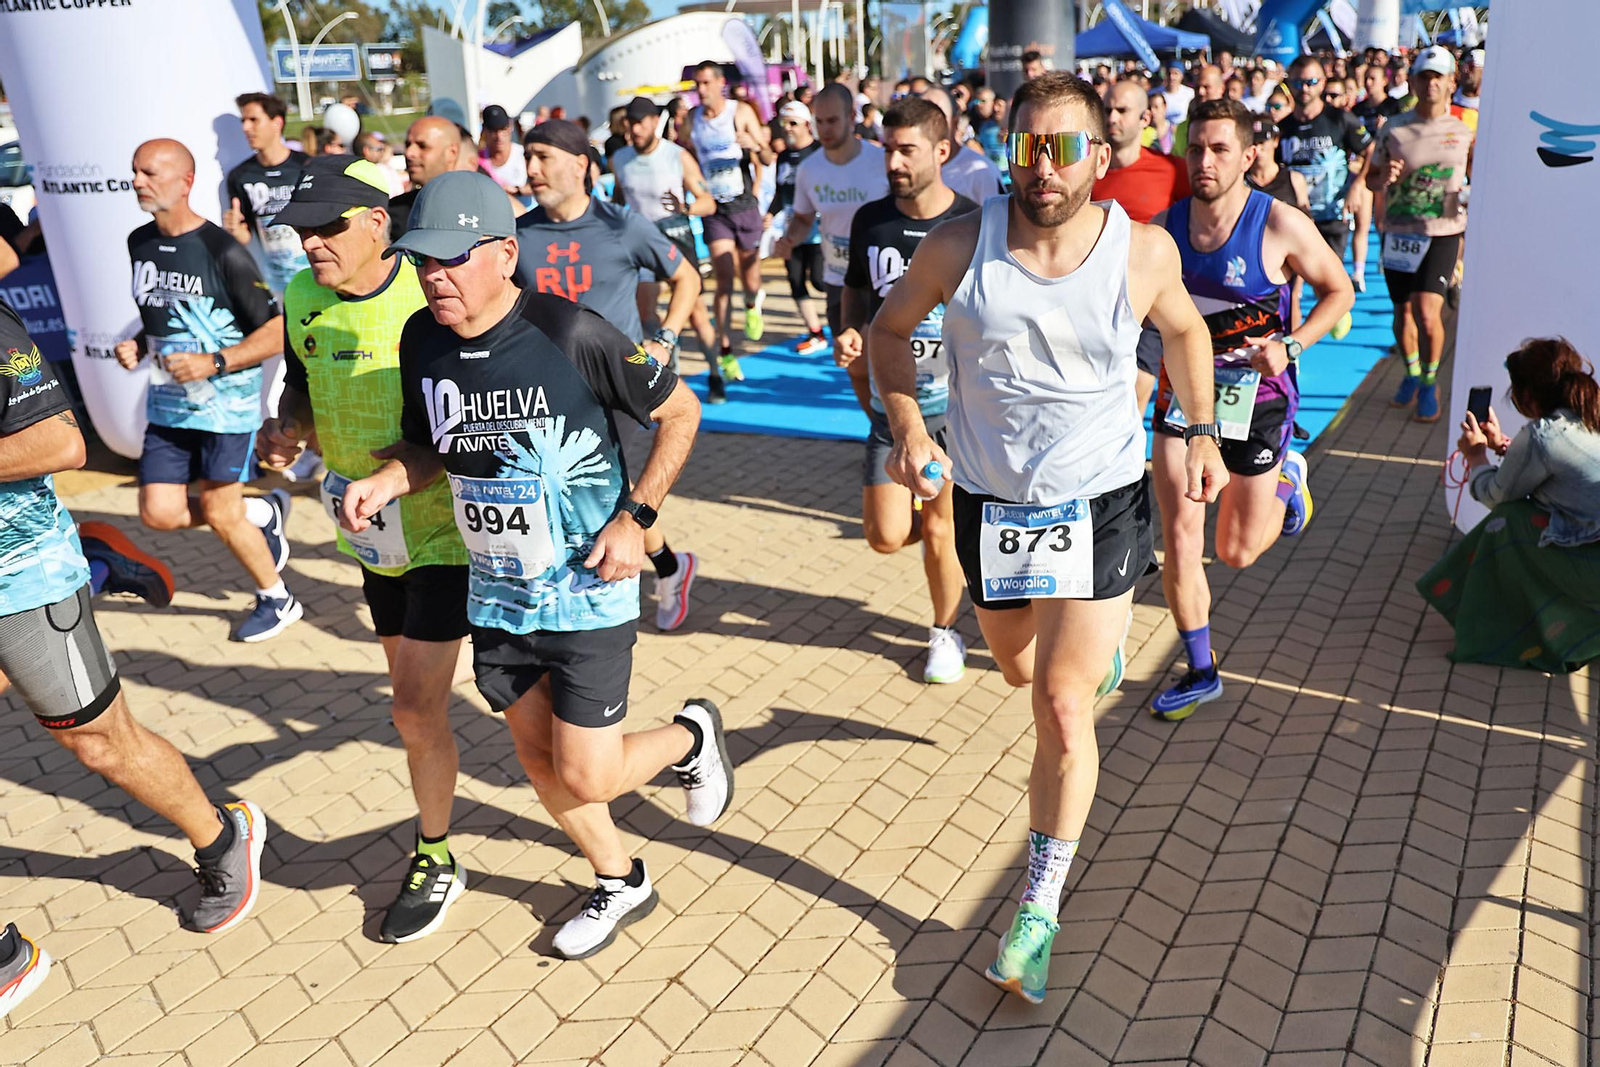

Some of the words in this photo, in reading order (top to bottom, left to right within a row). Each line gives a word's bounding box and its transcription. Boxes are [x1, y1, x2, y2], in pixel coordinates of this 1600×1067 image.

[43, 180, 103, 193] ATLANTIC
[1391, 238, 1420, 255] 358
[155, 269, 204, 296] HUELVA
[421, 377, 462, 454] 10
[460, 385, 550, 422] HUELVA
[463, 422, 486, 433] PUERTA
[486, 421, 496, 431] DEL
[513, 484, 537, 499] '24
[464, 502, 531, 535] 994
[1028, 506, 1064, 519] AVATEL
[1063, 501, 1085, 518] '24
[998, 524, 1072, 555] 873
[1001, 576, 1049, 591] Wayalia
